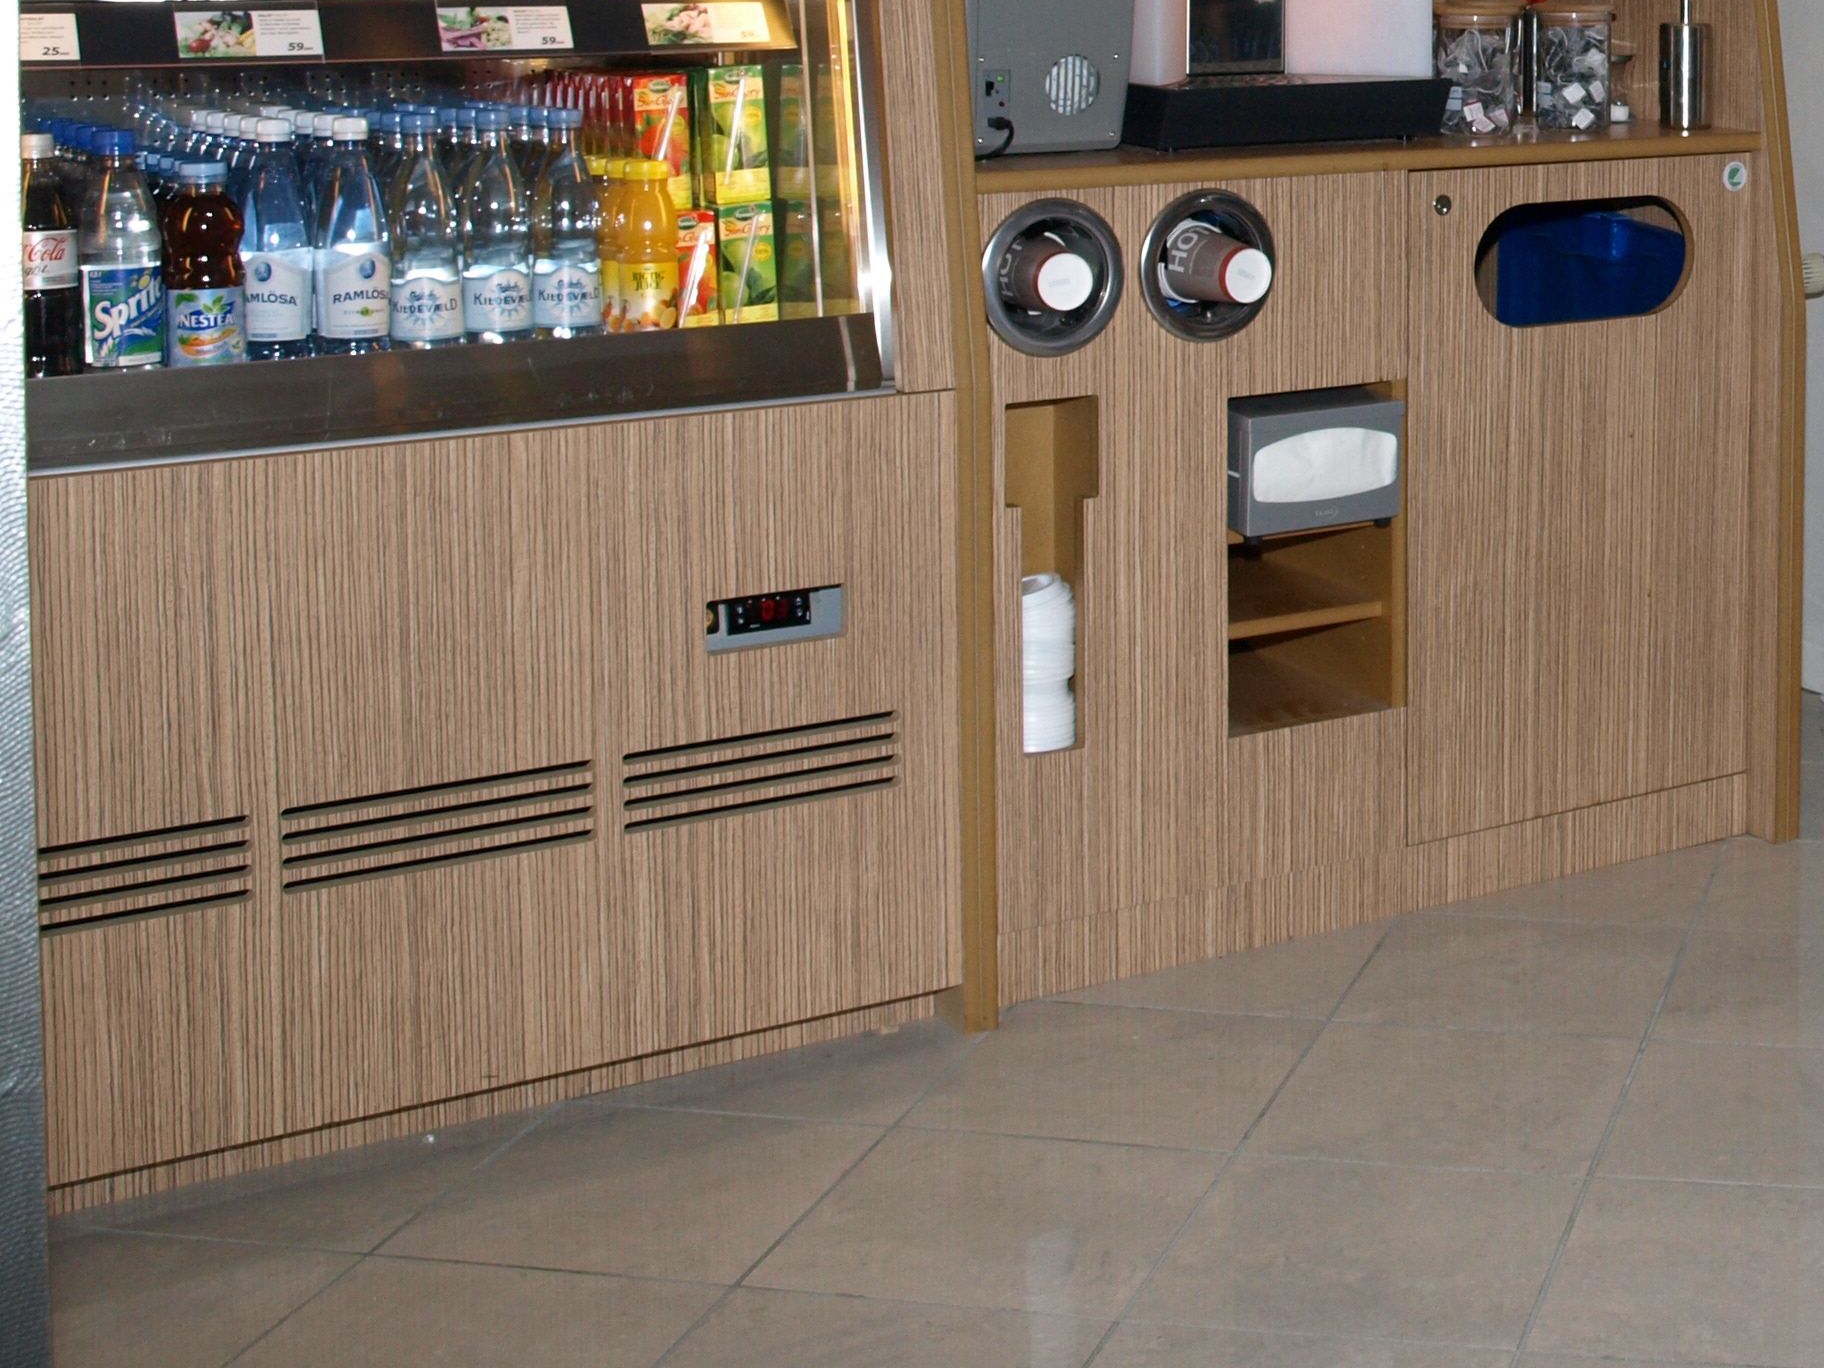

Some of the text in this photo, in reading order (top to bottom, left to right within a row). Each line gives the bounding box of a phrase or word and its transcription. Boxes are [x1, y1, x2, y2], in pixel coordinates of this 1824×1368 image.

[541, 35, 556, 45] 59
[42, 46, 60, 56] 25
[287, 41, 304, 52] 59
[473, 292, 532, 306] KILDEVÆL
[93, 275, 163, 341] Sprite
[177, 314, 234, 328] NESTEA
